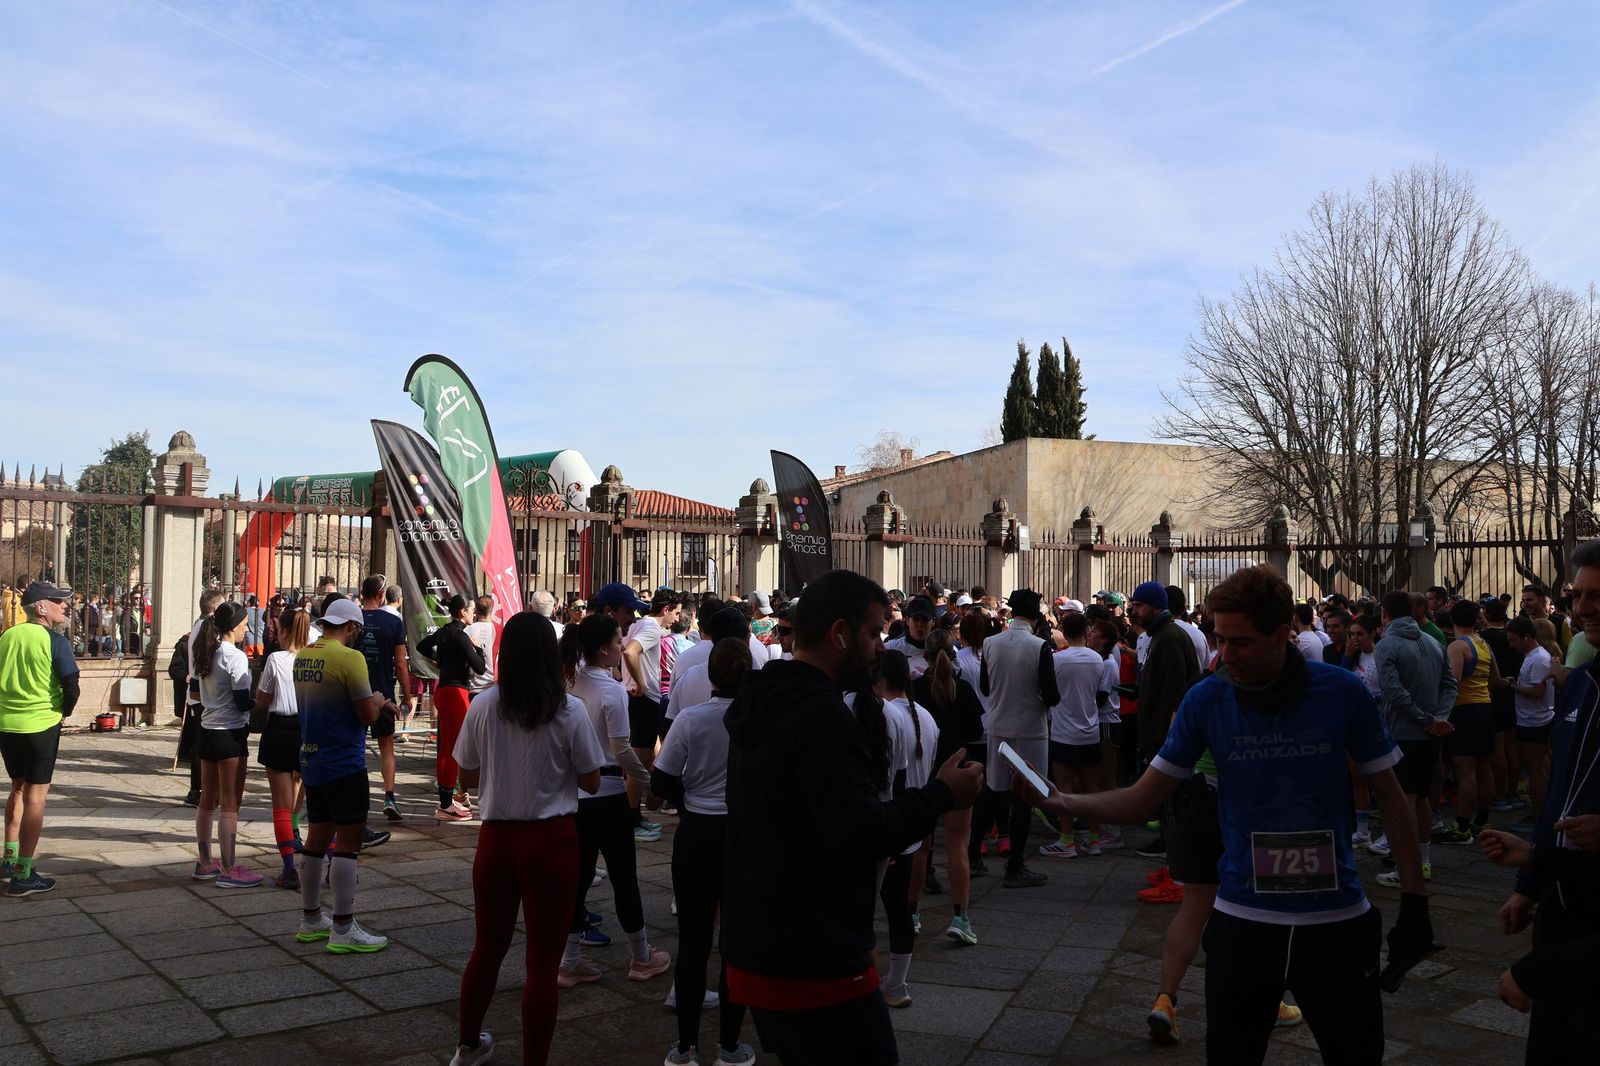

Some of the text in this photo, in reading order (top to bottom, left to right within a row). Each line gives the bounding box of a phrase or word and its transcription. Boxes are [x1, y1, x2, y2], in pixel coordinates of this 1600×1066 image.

[294, 658, 325, 670] RIATLON
[293, 670, 323, 683] UERO
[1230, 733, 1294, 746] TRAIL
[1227, 743, 1333, 760] AMIZADE
[1268, 848, 1320, 875] 725
